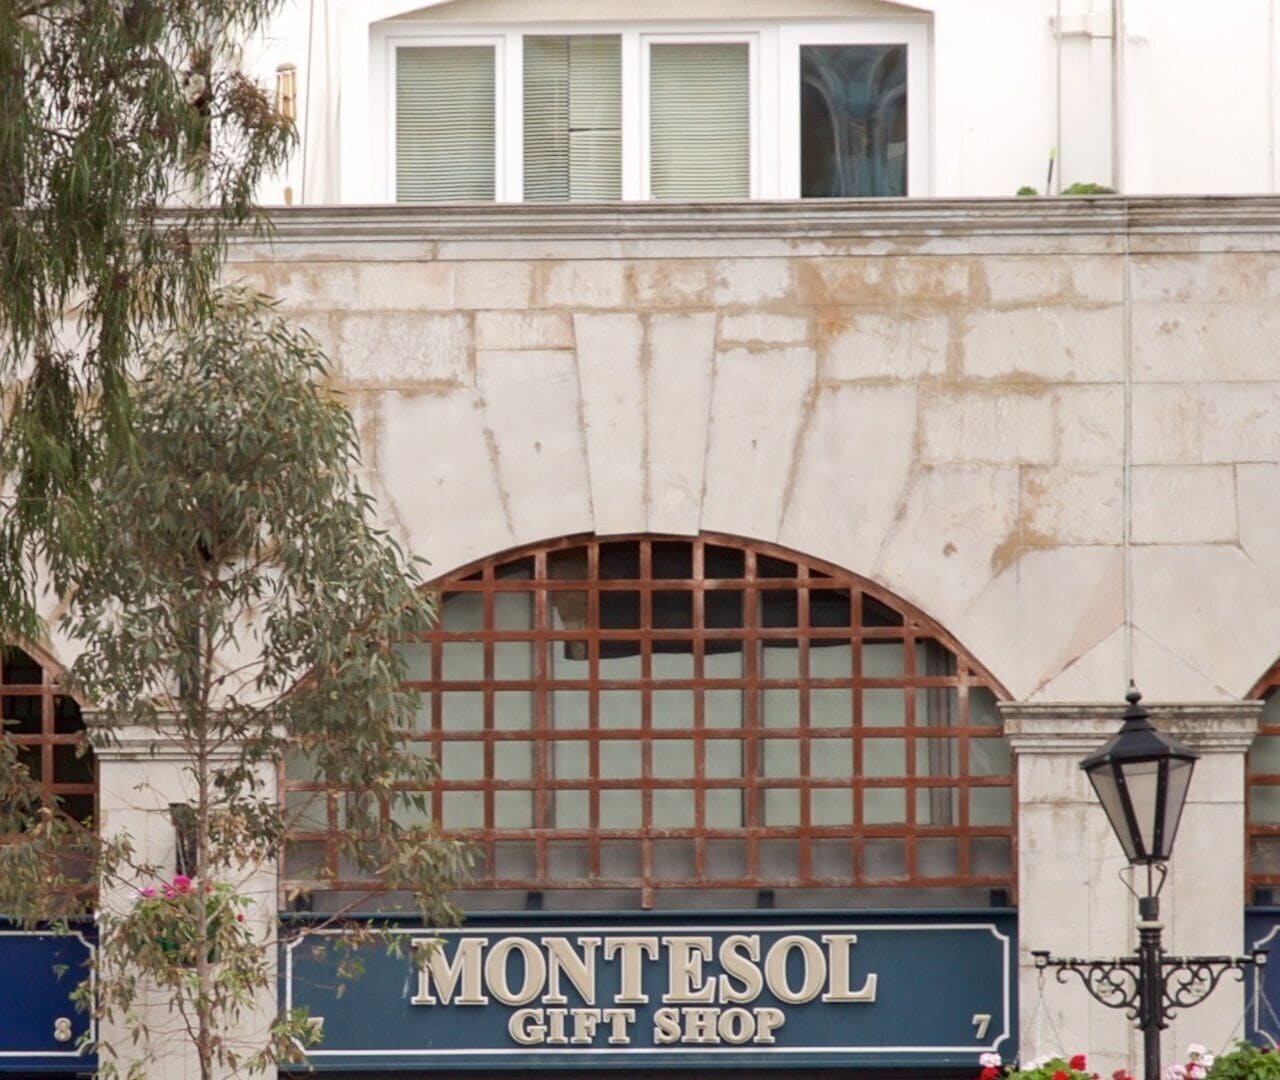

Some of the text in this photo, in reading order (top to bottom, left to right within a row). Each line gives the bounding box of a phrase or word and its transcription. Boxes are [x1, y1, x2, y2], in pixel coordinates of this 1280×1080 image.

[410, 934, 877, 1007] MONTESOL
[53, 1018, 72, 1042] 8
[508, 1007, 786, 1045] GIFT SHOP
[972, 1014, 991, 1039] 7
